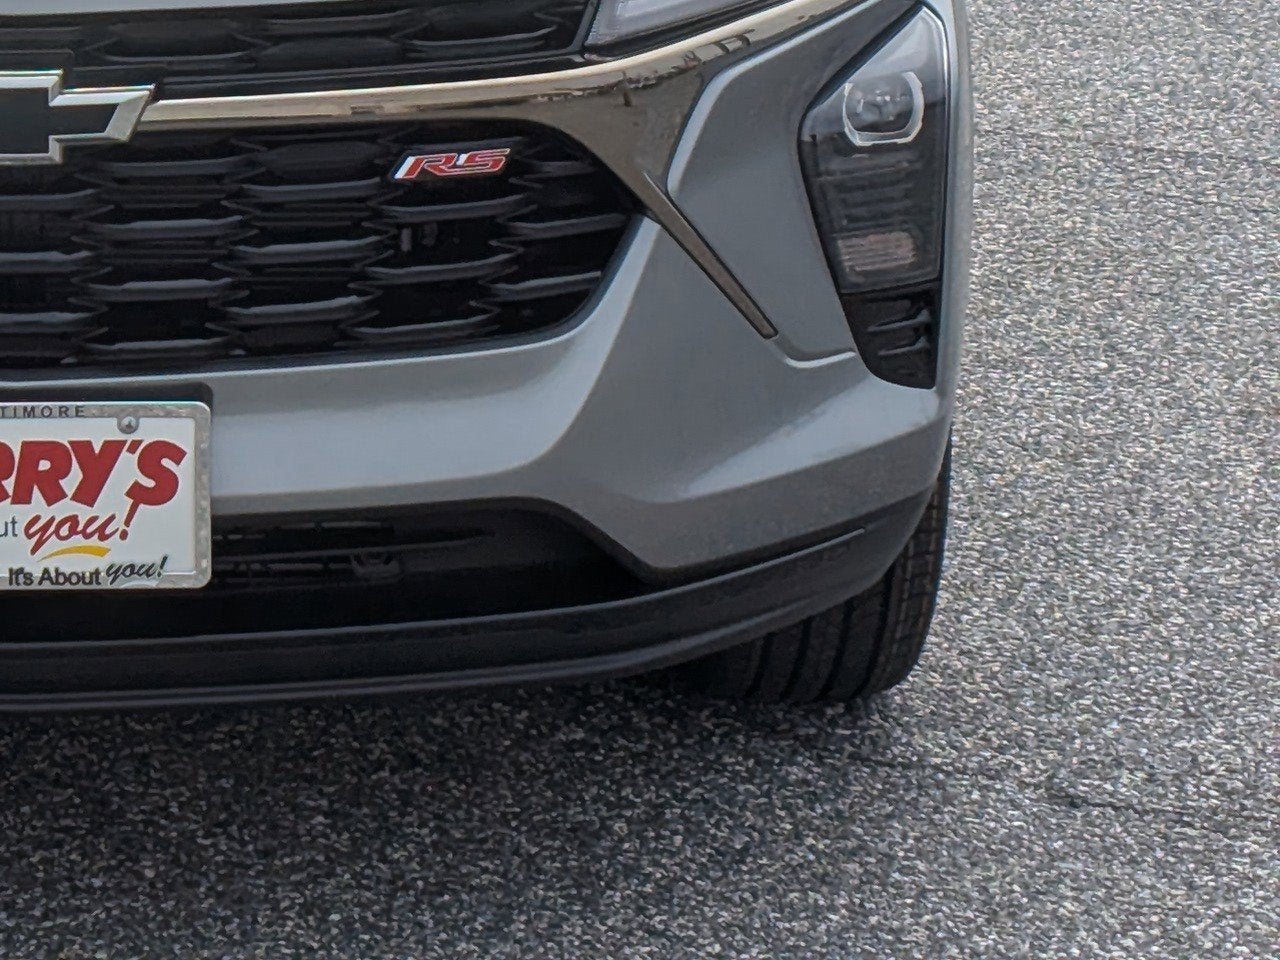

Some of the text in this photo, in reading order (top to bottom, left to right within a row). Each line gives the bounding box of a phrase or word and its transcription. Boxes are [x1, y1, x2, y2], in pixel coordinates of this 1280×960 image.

[395, 148, 511, 180] RS
[24, 501, 139, 556] you!
[8, 567, 35, 586] It's
[38, 567, 101, 586] About
[106, 556, 168, 580] you!
